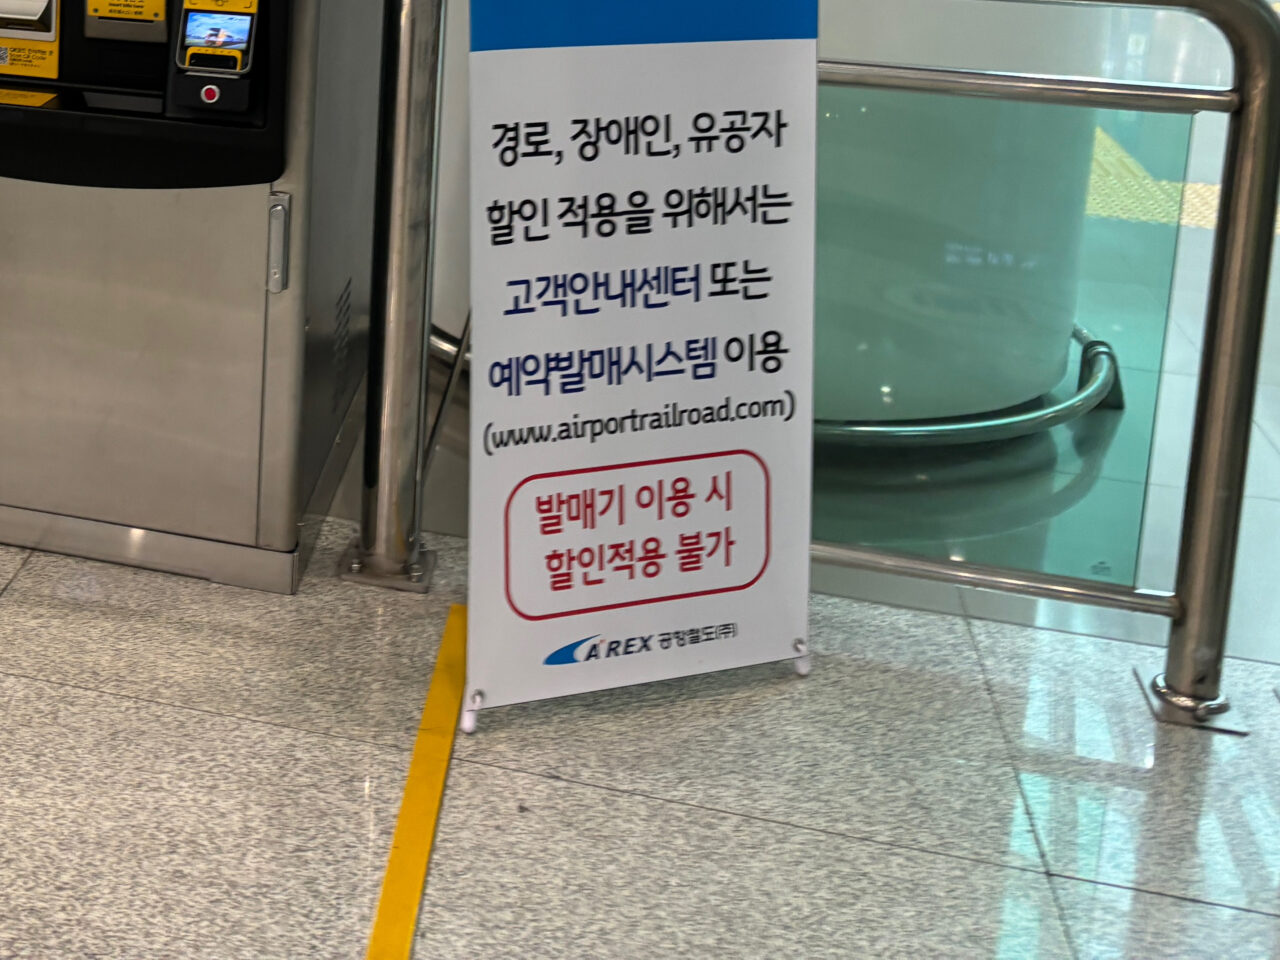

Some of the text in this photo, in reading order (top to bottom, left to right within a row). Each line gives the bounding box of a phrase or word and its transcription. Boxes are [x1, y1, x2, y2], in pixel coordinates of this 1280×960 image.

[491, 109, 789, 167] 경로, 장애인, 유공자
[486, 184, 794, 246] 할인 적용을 위해서는
[503, 259, 773, 317] 고객안내센터 또는
[489, 330, 790, 397] 예약발매시스템 이용
[483, 390, 796, 456] (www.airportrailroad.com)
[535, 470, 733, 535] 발매기 이용 시
[544, 526, 736, 592] 할인적용 불가
[657, 623, 739, 651] 공항철도(주)
